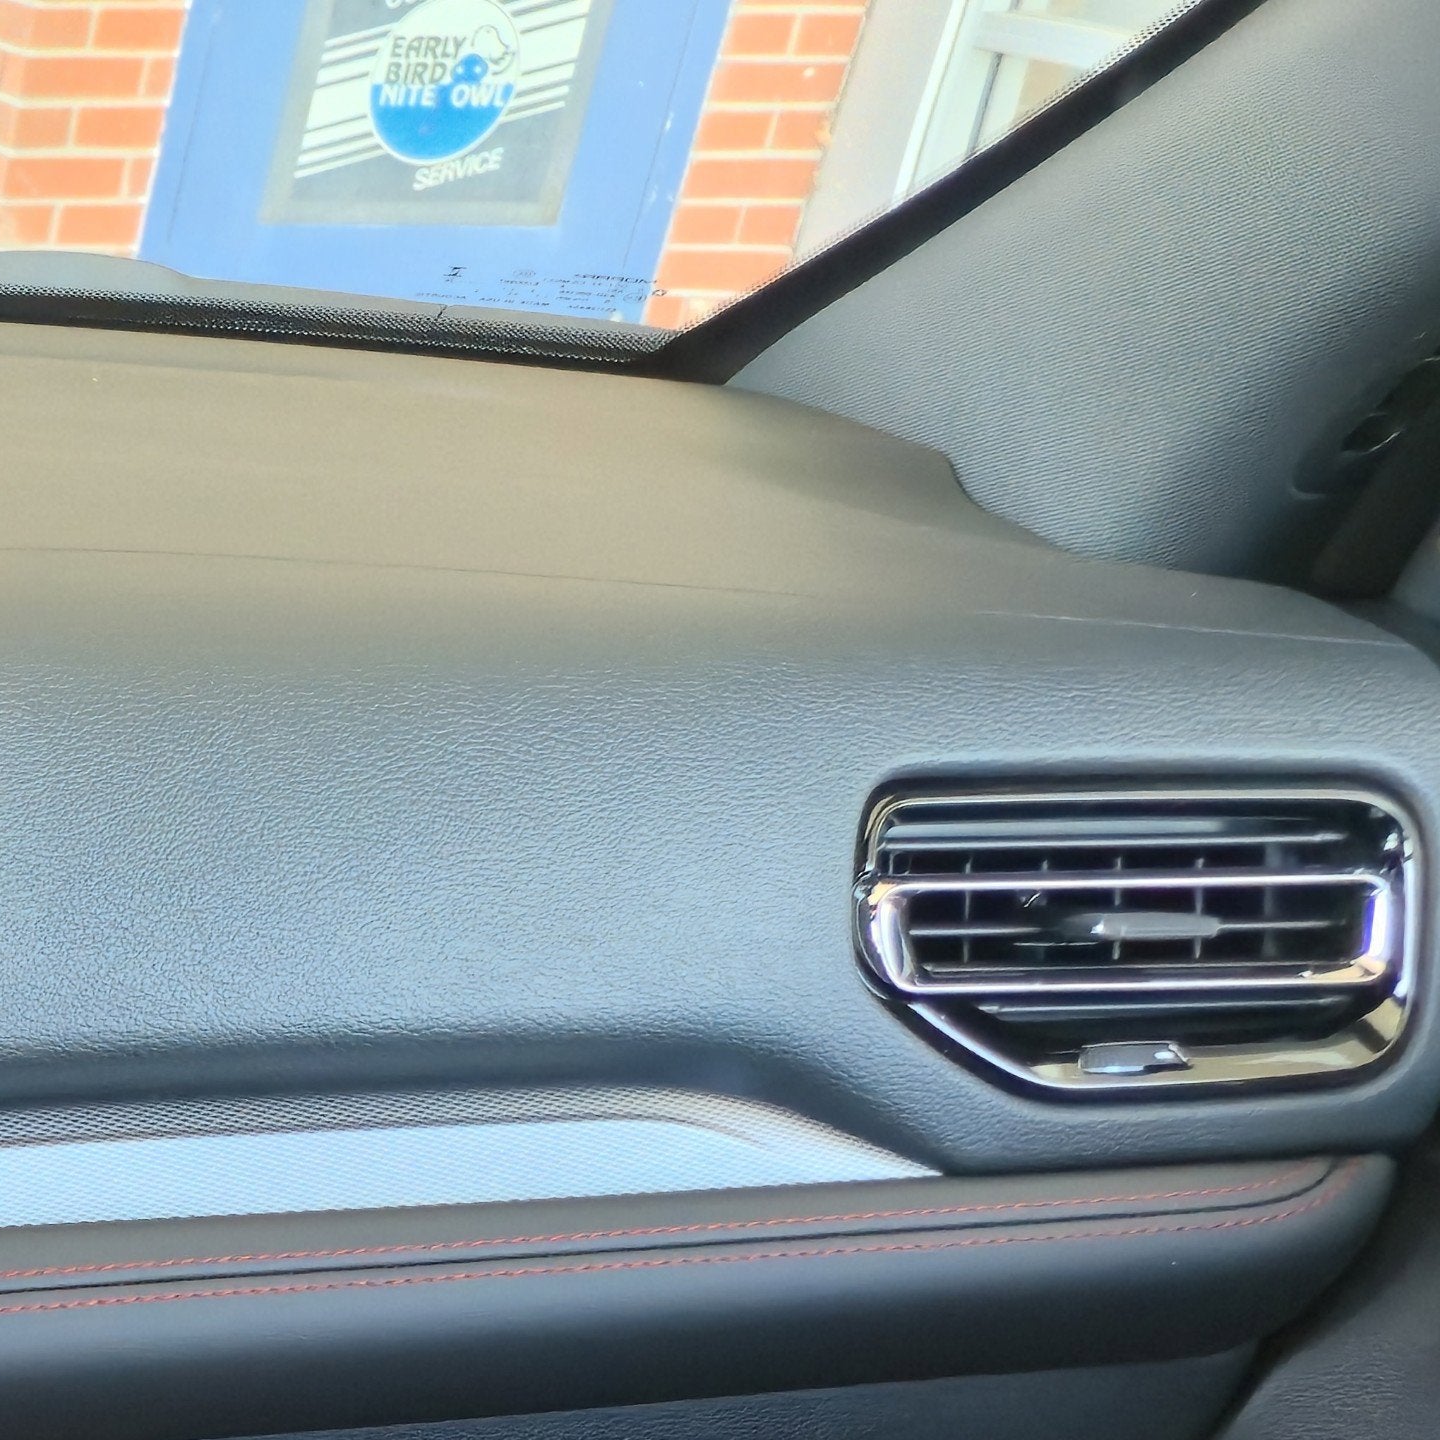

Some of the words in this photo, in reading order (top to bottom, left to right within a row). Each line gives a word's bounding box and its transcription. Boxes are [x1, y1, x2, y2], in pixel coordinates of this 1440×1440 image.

[389, 35, 468, 60] EARLY
[384, 61, 448, 86] BIRD
[379, 83, 437, 108] NITE
[450, 82, 506, 109] OWL
[412, 146, 505, 192] SERVICE
